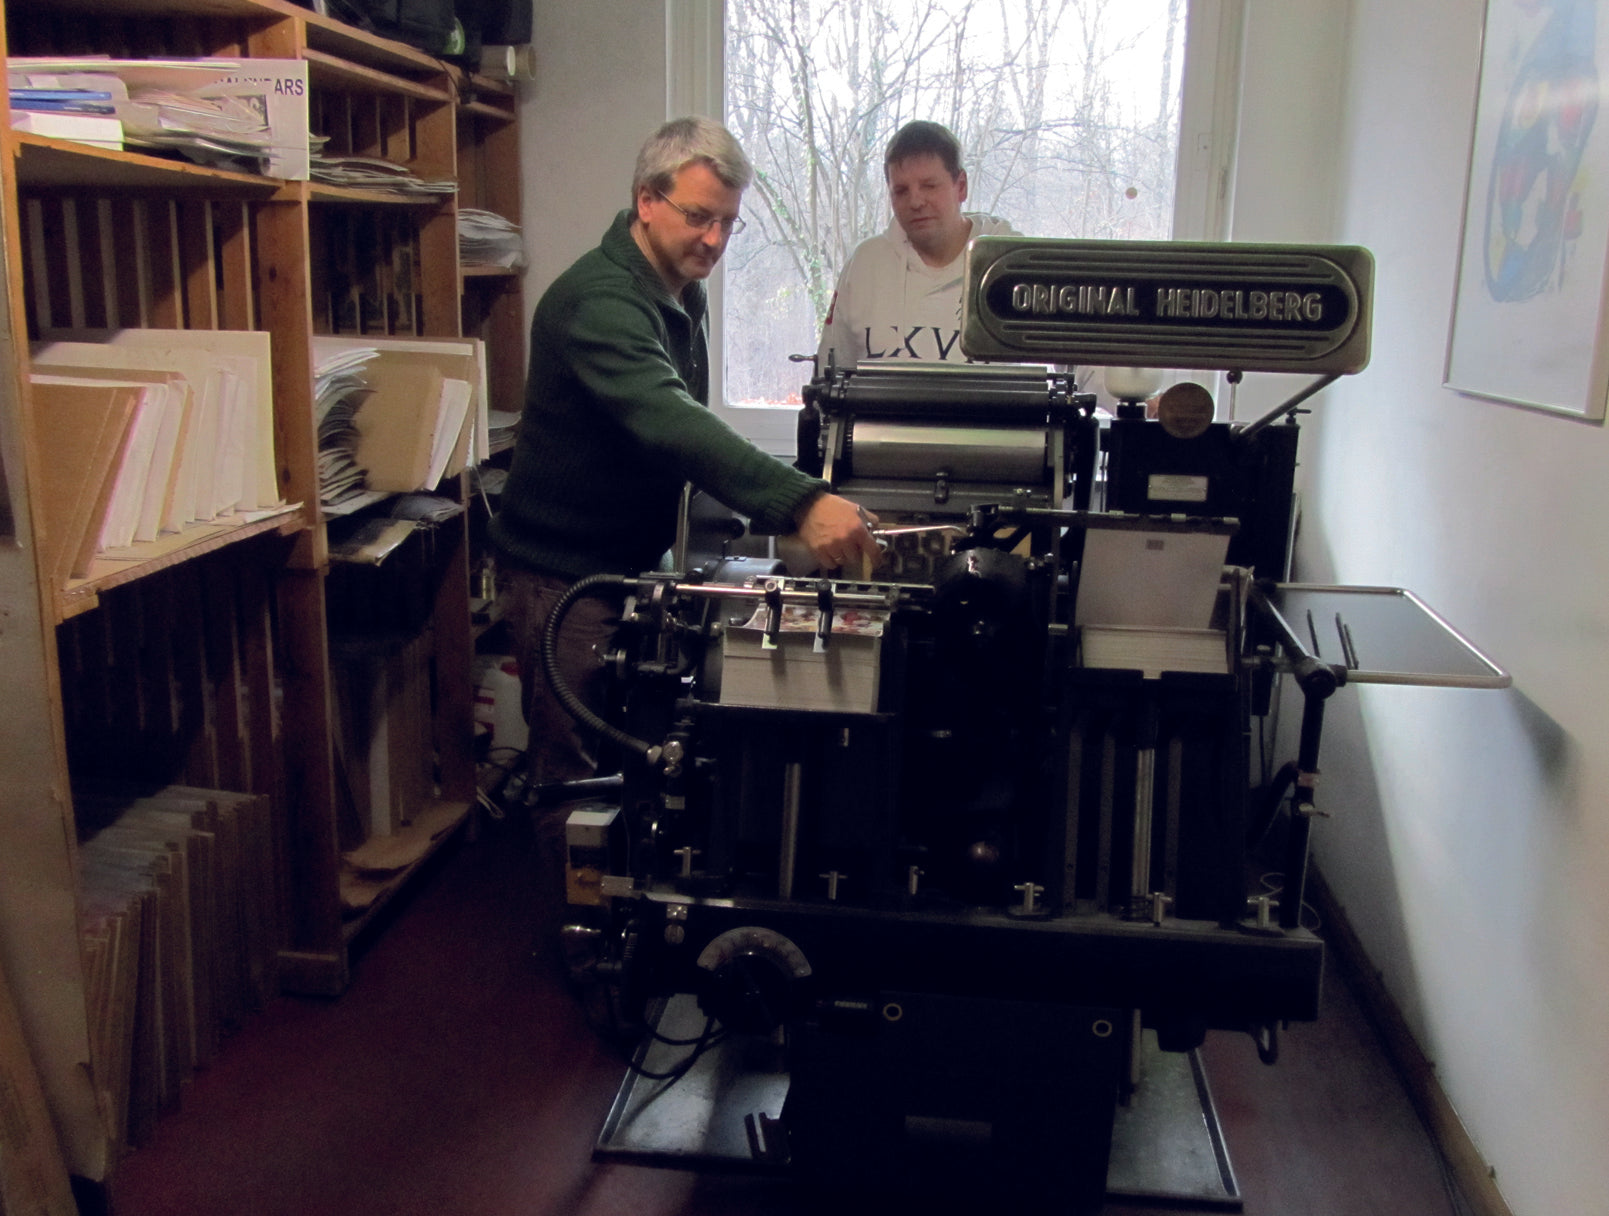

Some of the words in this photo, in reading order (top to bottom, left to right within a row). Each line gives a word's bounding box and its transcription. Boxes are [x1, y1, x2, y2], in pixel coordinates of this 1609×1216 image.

[1011, 284, 1139, 317] ORIGINAL
[1156, 288, 1323, 321] HEIDELBERG
[865, 326, 987, 363] LXV
